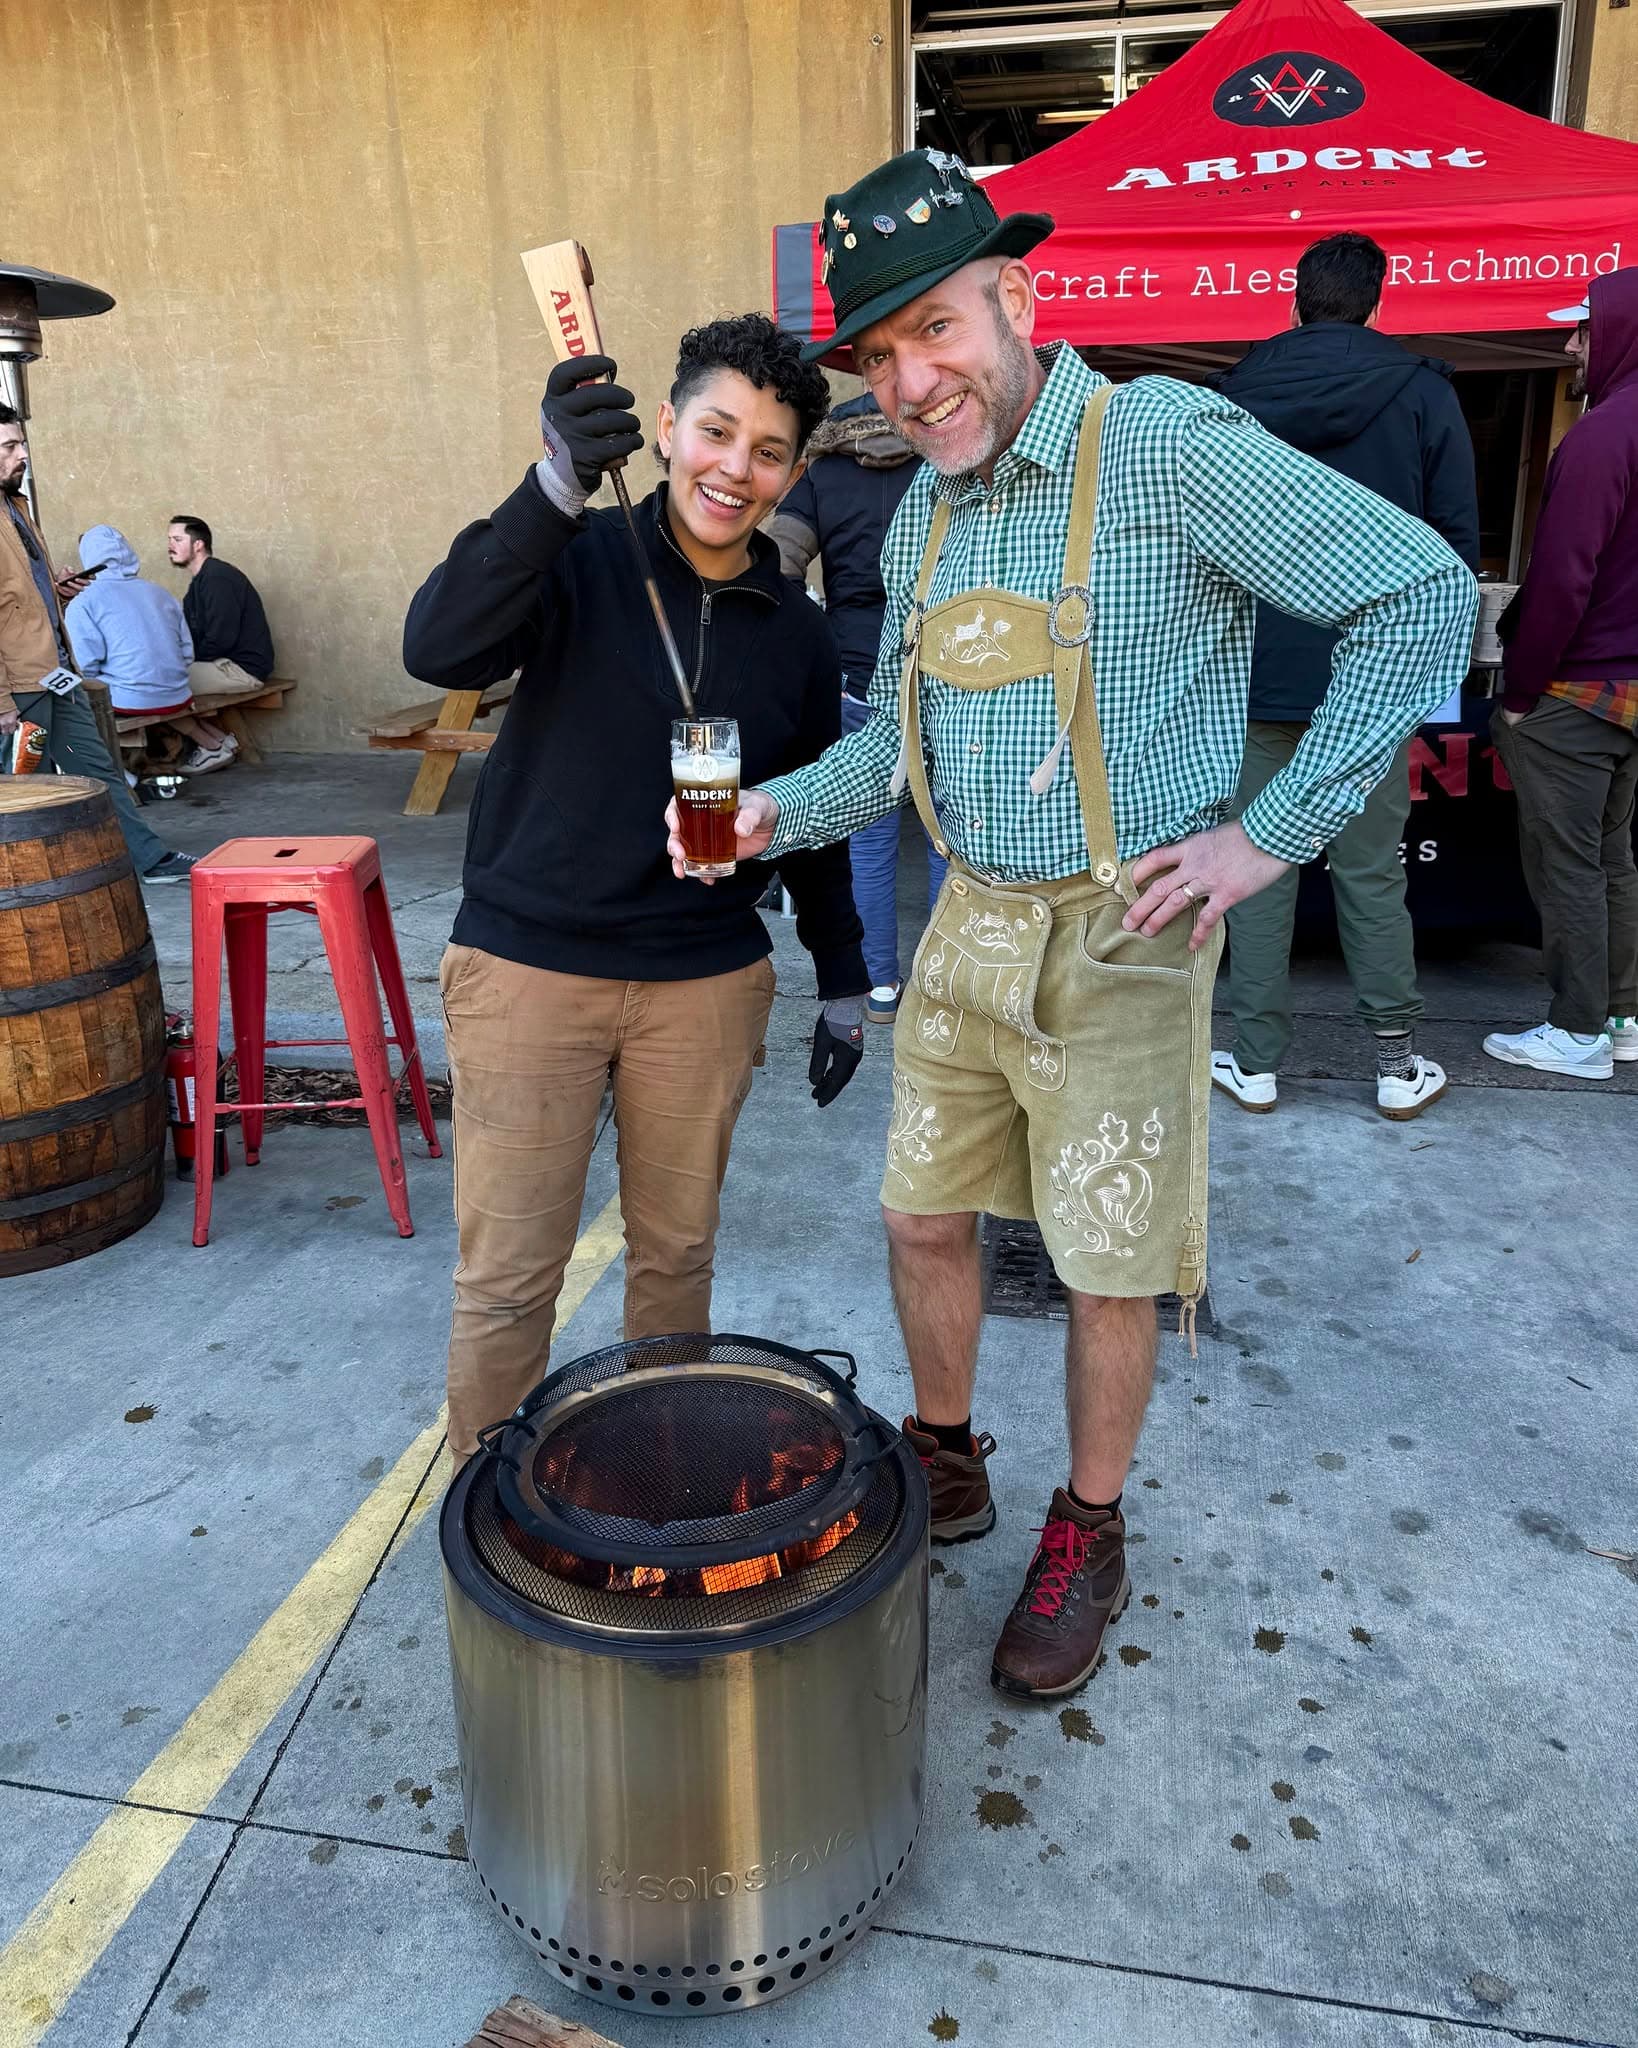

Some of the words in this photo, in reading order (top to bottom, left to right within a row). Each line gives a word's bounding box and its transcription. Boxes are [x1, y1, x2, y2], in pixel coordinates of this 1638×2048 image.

[1194, 181, 1296, 198] CRAFT
[1319, 178, 1398, 188] ALES
[1032, 266, 1163, 302] Craft
[1190, 262, 1299, 296] Ales
[1387, 241, 1622, 286] Richmond
[550, 289, 587, 358] ARD
[48, 672, 74, 690] 16
